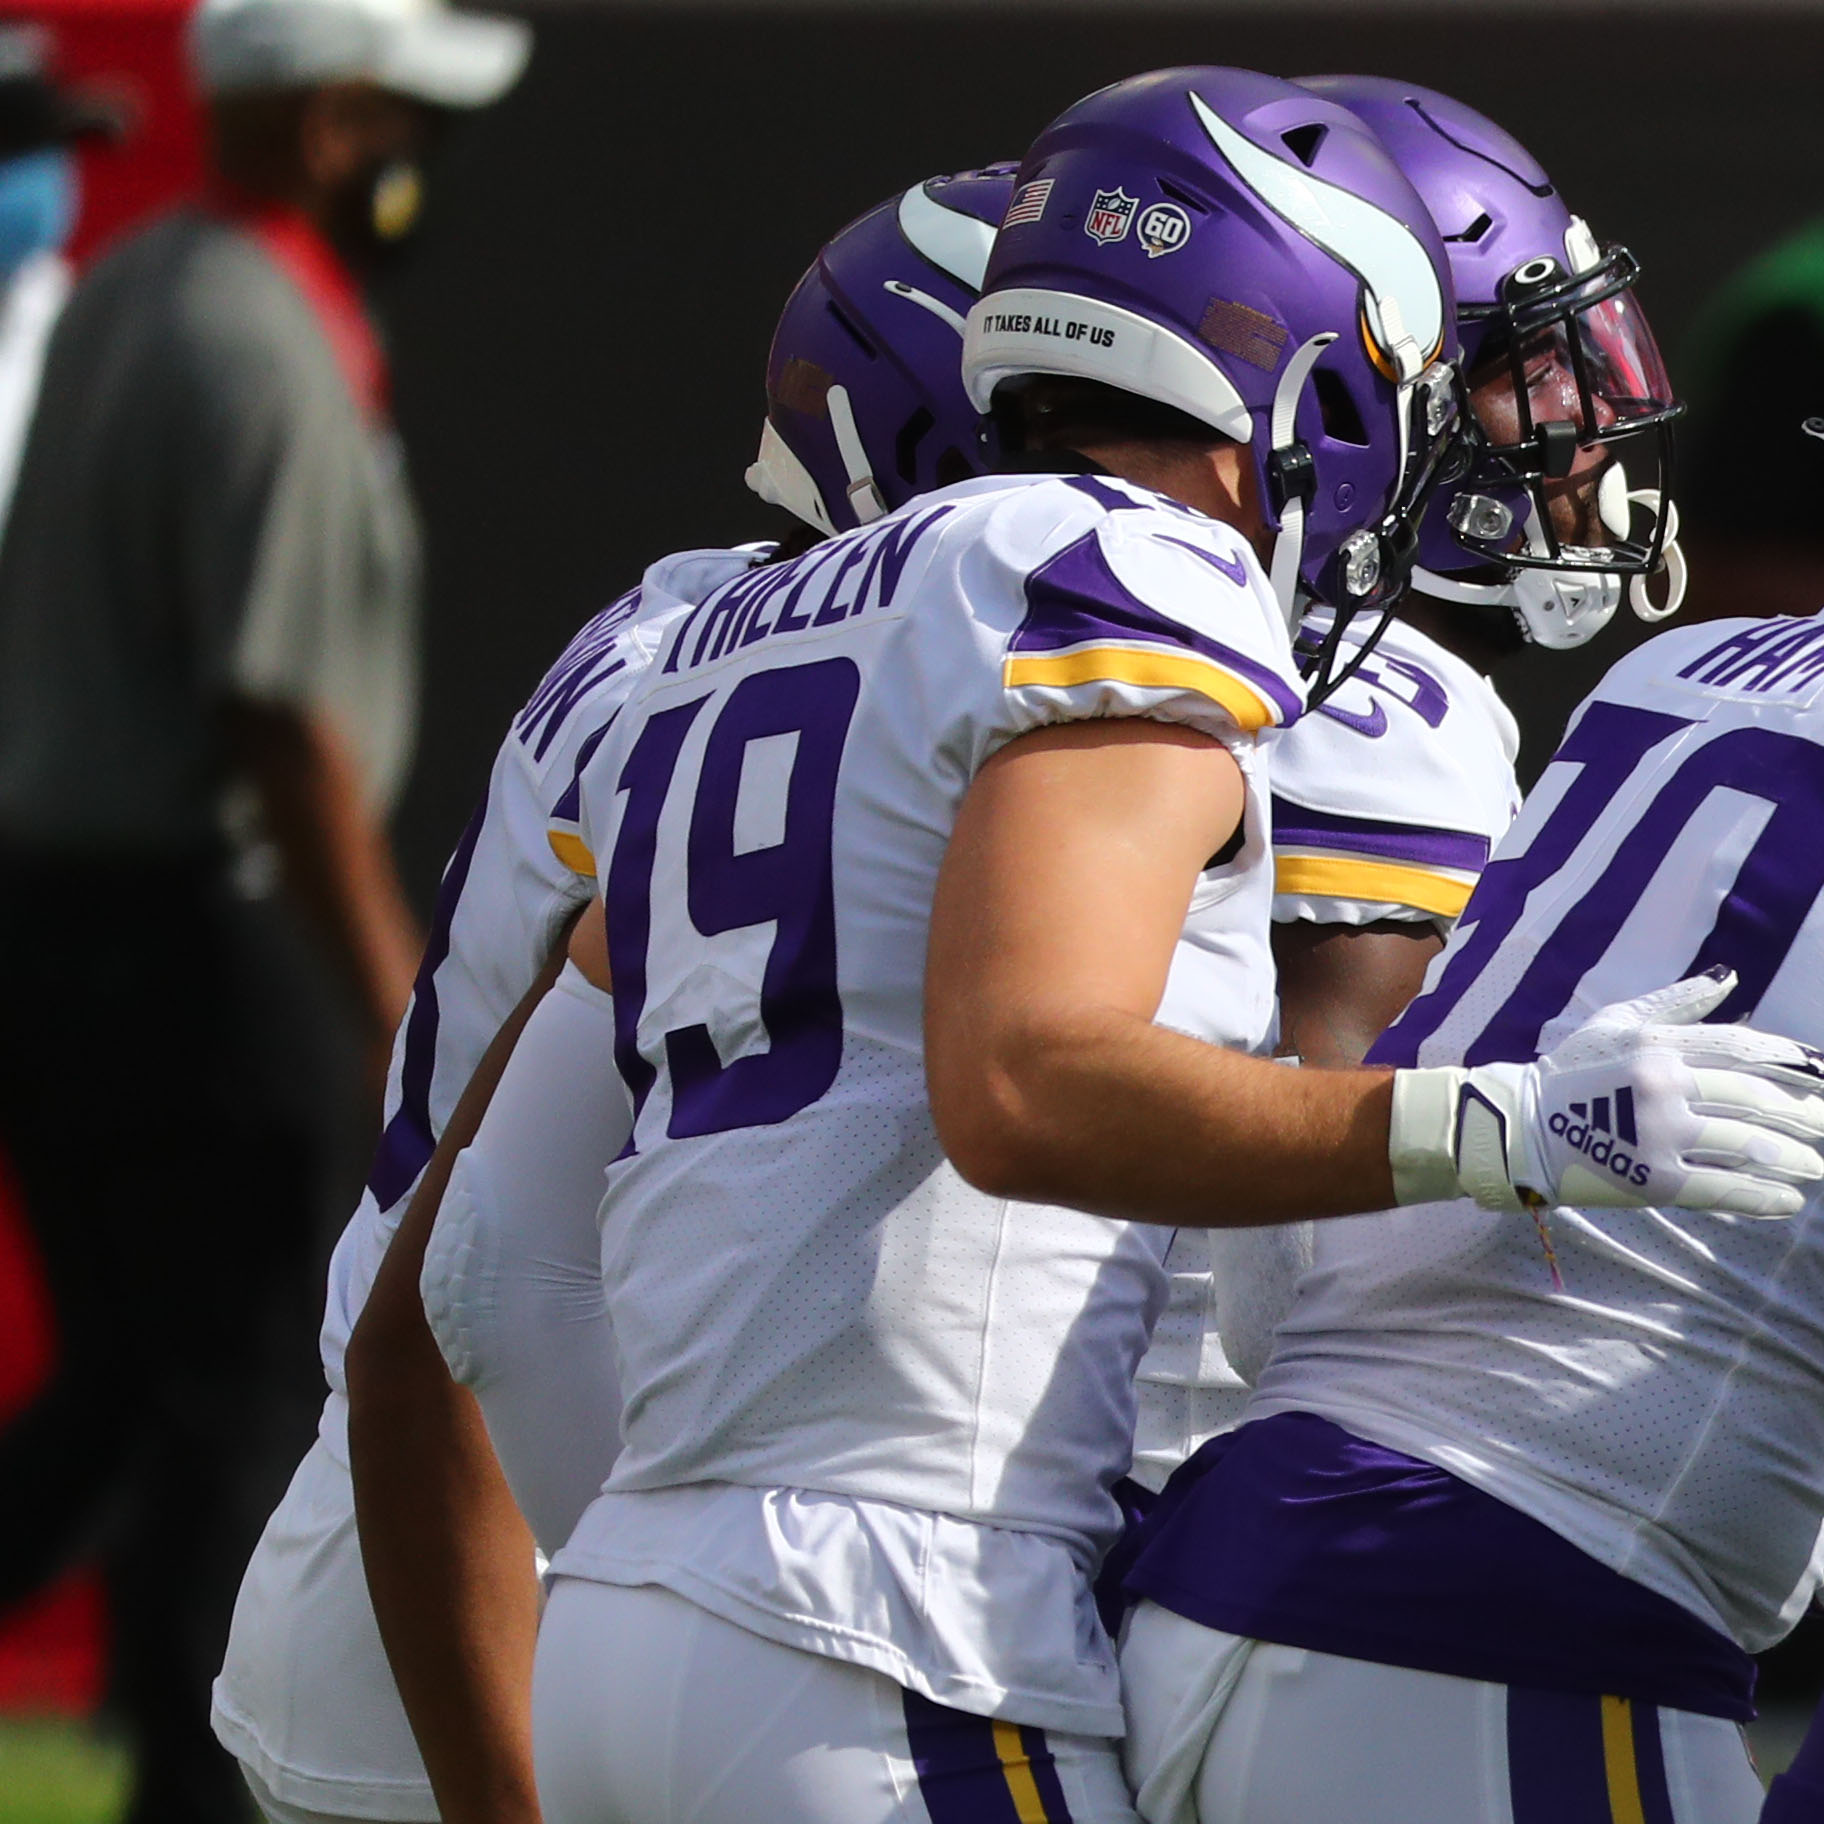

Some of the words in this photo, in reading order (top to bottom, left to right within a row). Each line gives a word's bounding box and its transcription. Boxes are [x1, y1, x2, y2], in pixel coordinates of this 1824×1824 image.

[1090, 209, 1123, 236] NFL
[1144, 211, 1185, 245] 60
[983, 315, 996, 334] IT
[995, 314, 1032, 334] TAKES
[1033, 316, 1062, 338] ALL
[1065, 321, 1087, 340] OF
[1090, 327, 1116, 348] US
[662, 504, 957, 674] THIELEN
[604, 656, 861, 1162] 19
[1548, 1112, 1651, 1186] adidas
